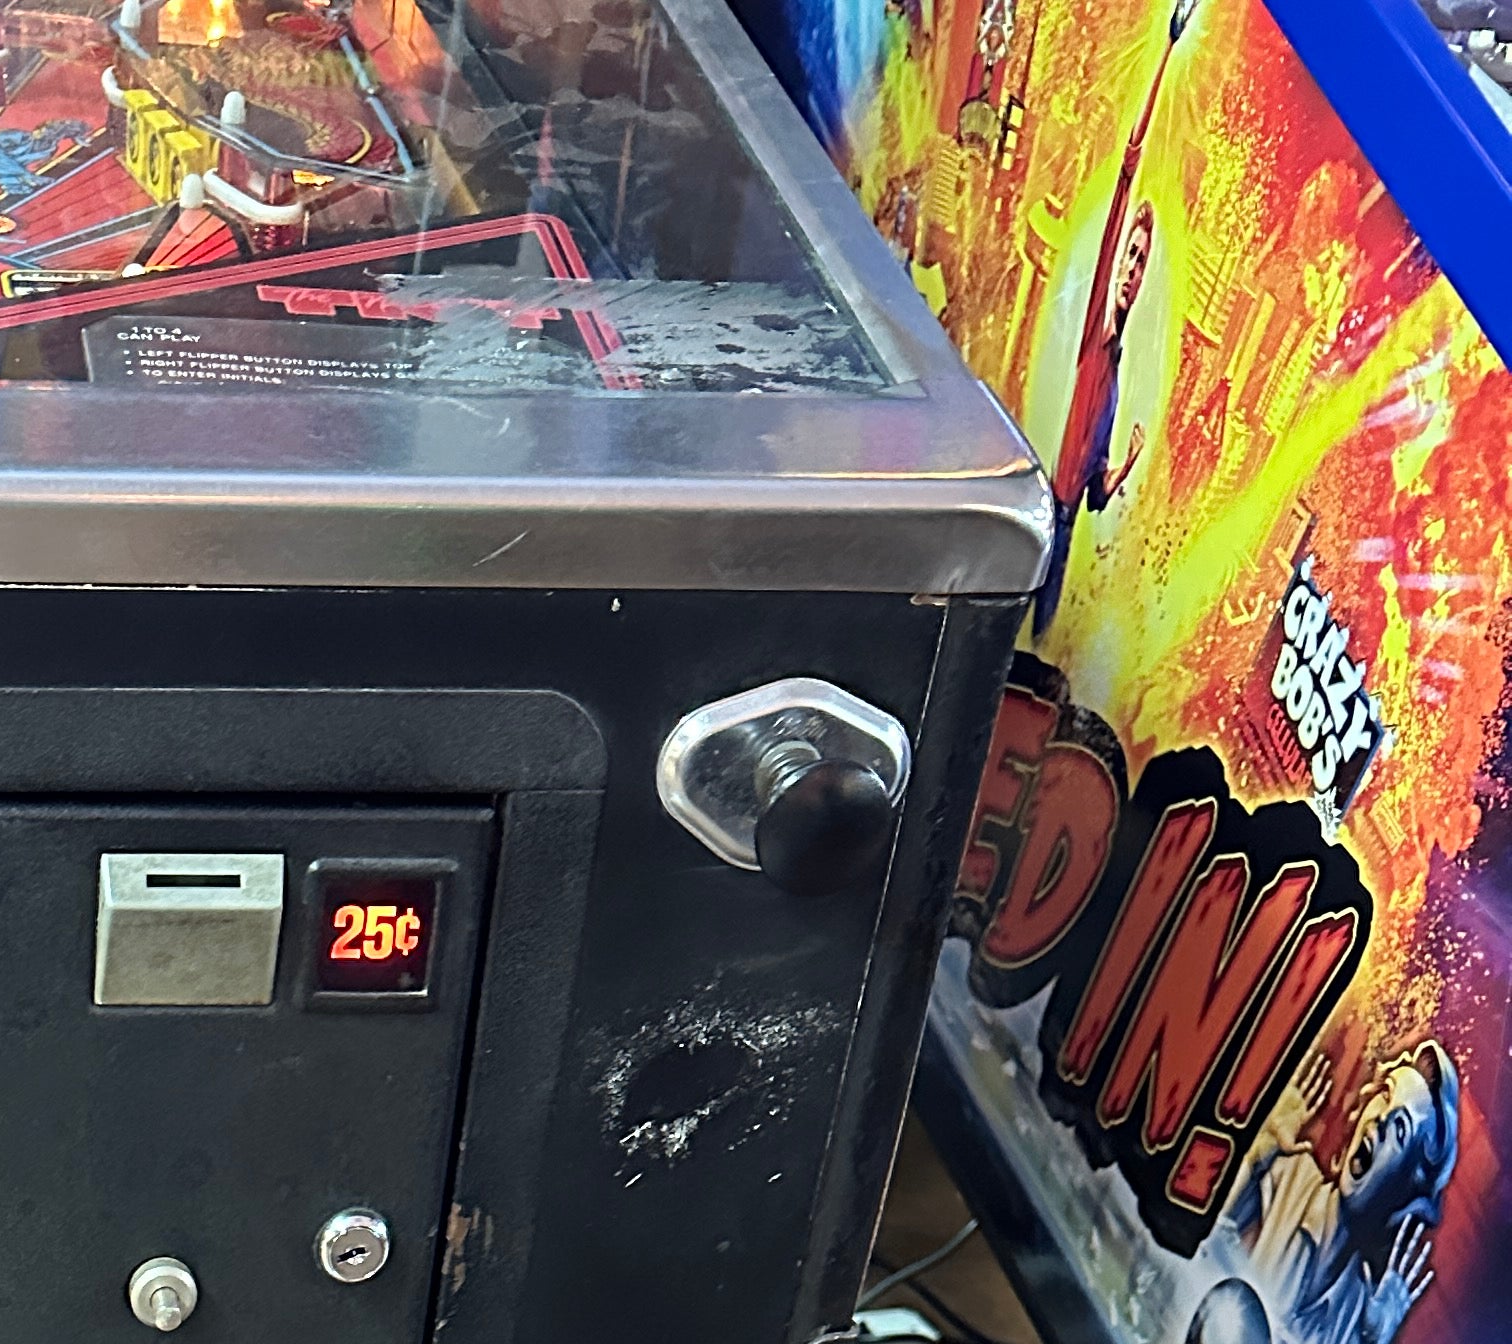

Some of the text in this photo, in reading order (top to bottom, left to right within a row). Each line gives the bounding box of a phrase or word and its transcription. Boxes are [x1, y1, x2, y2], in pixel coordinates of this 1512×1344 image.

[116, 333, 201, 343] CAN PLAY
[144, 326, 167, 335] TO
[140, 359, 184, 368] RIGHT
[190, 361, 249, 371] FLIPPER
[255, 366, 315, 376] BUTTON
[319, 370, 390, 379] DISPLAYS
[179, 351, 238, 361] FLIPPER
[243, 355, 303, 365] BUTTON
[307, 359, 379, 369] DISPLAYS
[142, 369, 163, 377] TO
[168, 371, 217, 379] ENTER
[1283, 584, 1372, 763] CRAZY
[1271, 642, 1342, 791] BOB'S
[328, 904, 421, 961] 25¢
[1057, 796, 1359, 1215] IN!
